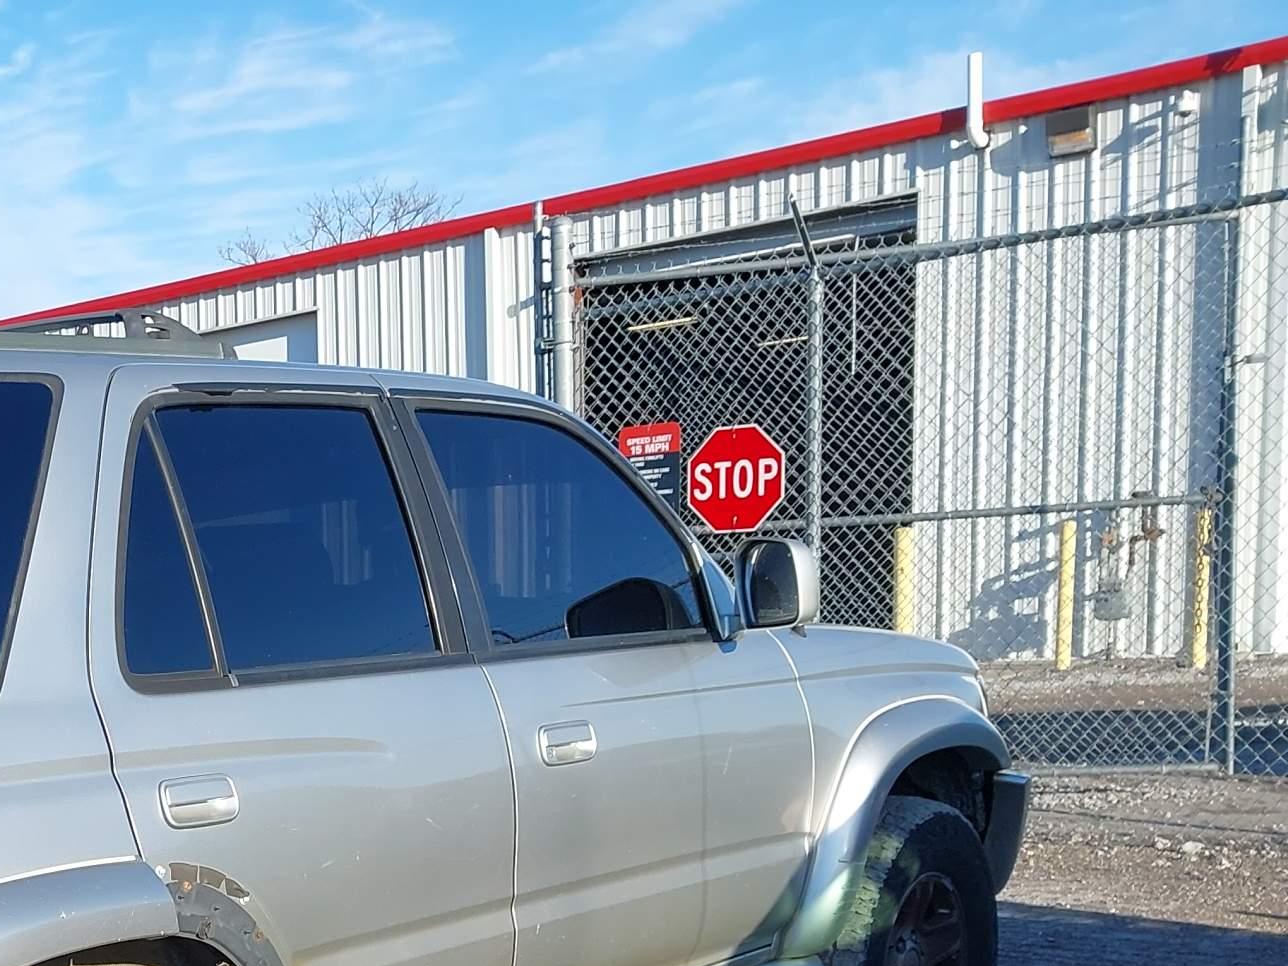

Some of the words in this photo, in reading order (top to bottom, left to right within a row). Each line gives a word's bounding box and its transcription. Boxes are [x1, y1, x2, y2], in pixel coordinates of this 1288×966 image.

[626, 436, 651, 446] SPEED
[652, 433, 673, 444] LIMIT
[630, 445, 643, 455] 15
[644, 441, 670, 454] MPH
[693, 457, 779, 501] STOP
